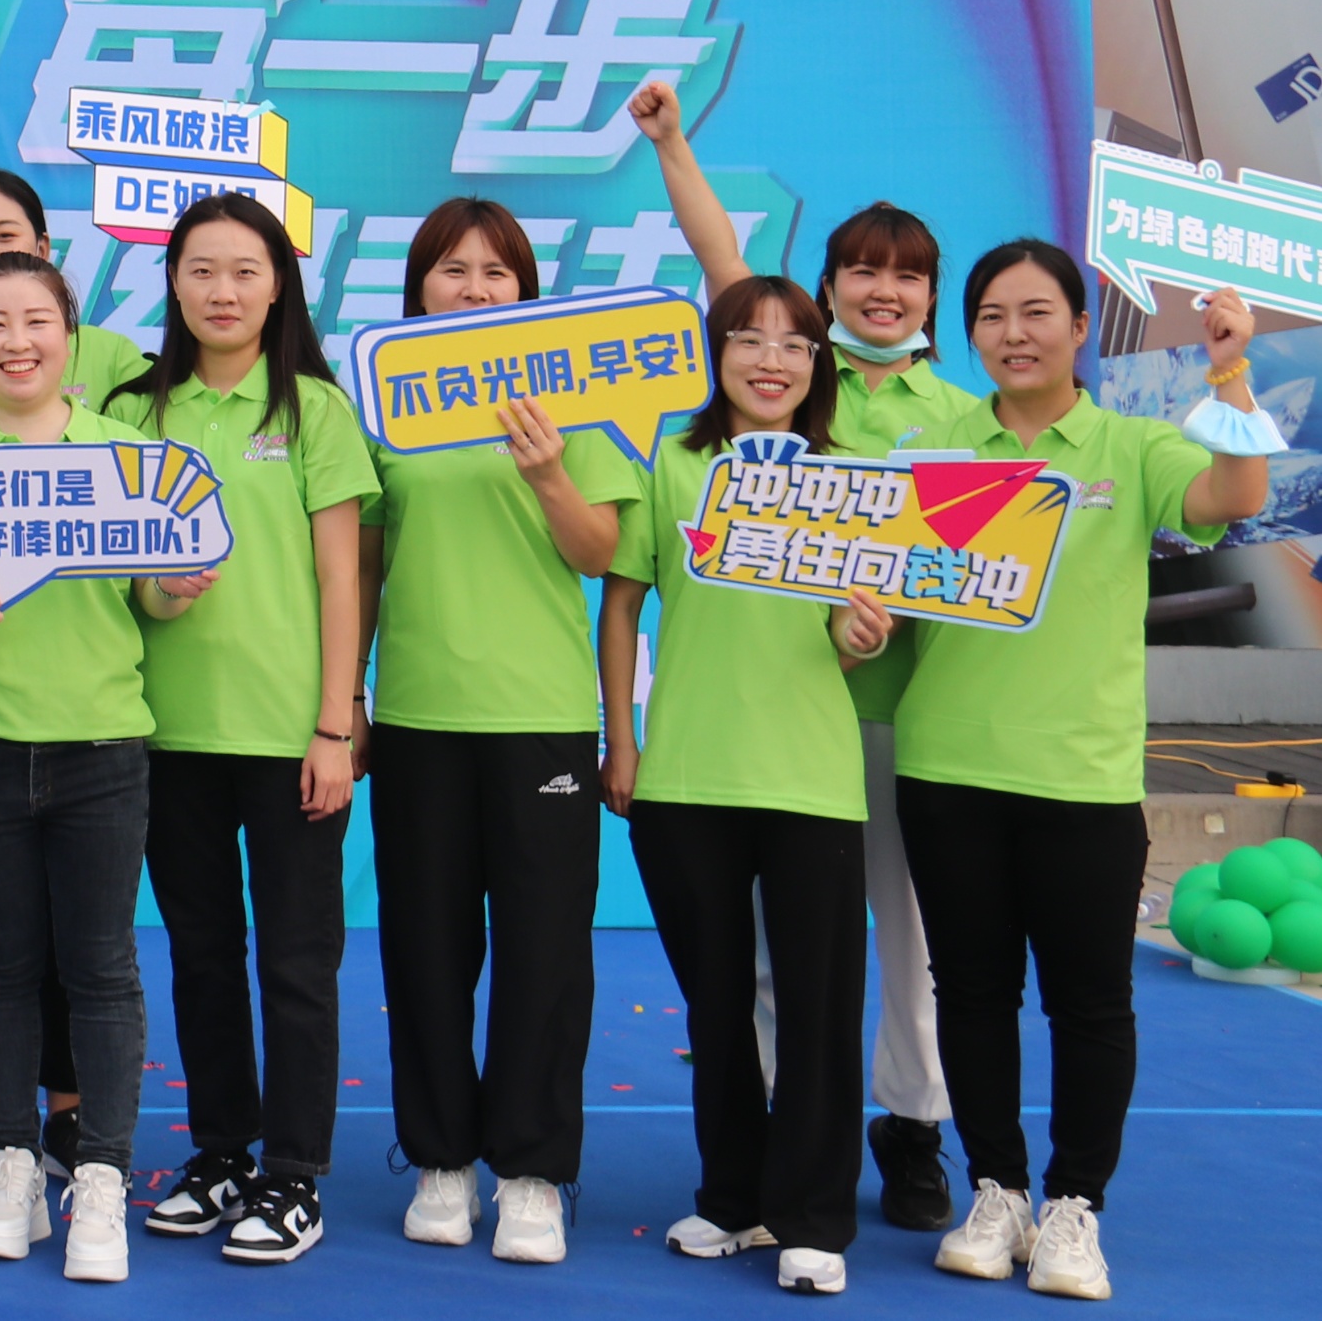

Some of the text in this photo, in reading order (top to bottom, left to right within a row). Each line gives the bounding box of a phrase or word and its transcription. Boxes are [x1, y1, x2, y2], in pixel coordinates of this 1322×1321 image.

[75, 100, 250, 154] 乘风破浪
[1106, 197, 1322, 285] 为绿色领跑代
[717, 458, 909, 527] 冲冲冲
[719, 519, 1031, 609] 勇往向钱冲
